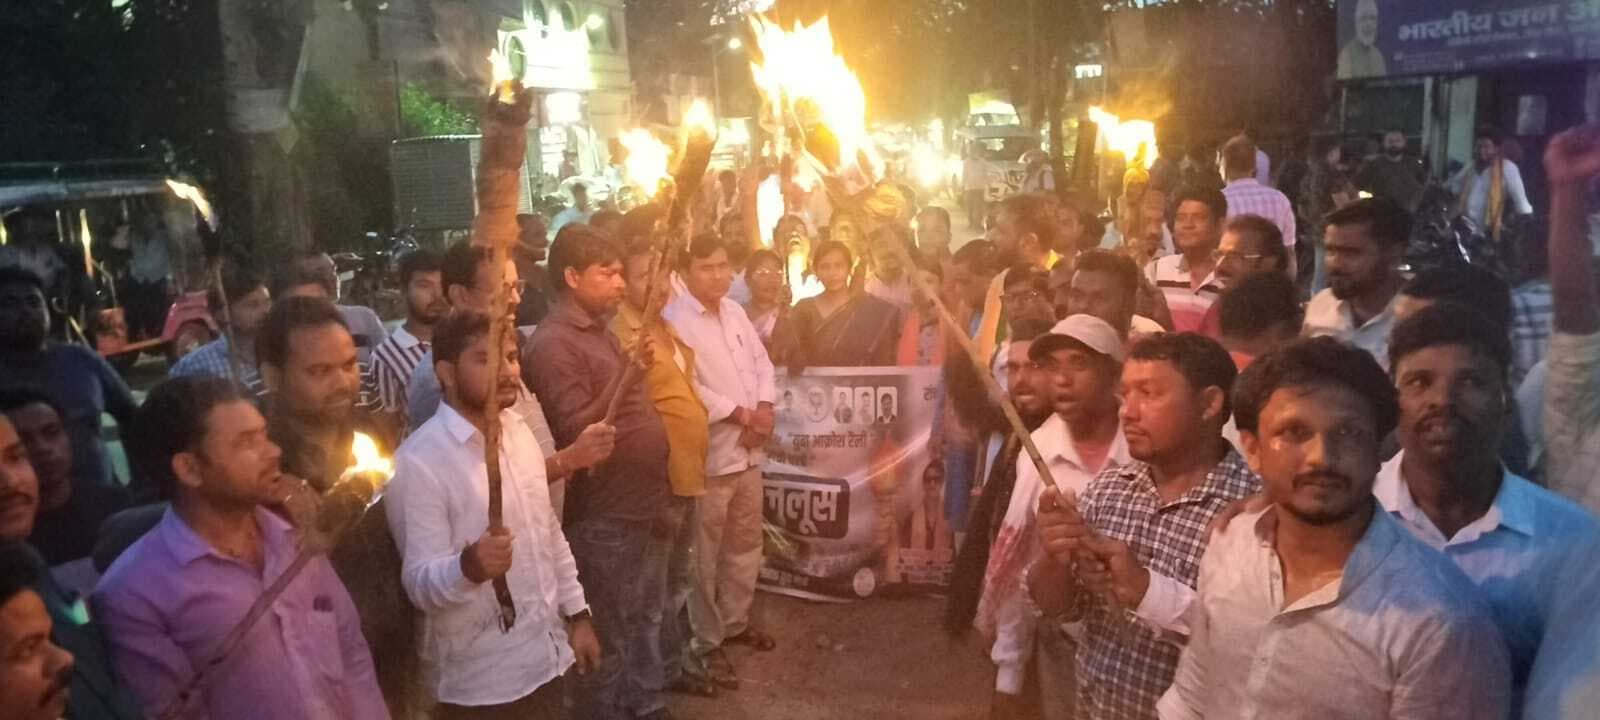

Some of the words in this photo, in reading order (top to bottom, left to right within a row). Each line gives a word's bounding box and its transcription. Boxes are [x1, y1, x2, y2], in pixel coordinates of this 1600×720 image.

[1398, 10, 1492, 41] भारतीय
[1496, 4, 1561, 28] जन
[813, 430, 846, 449] आक्रोश
